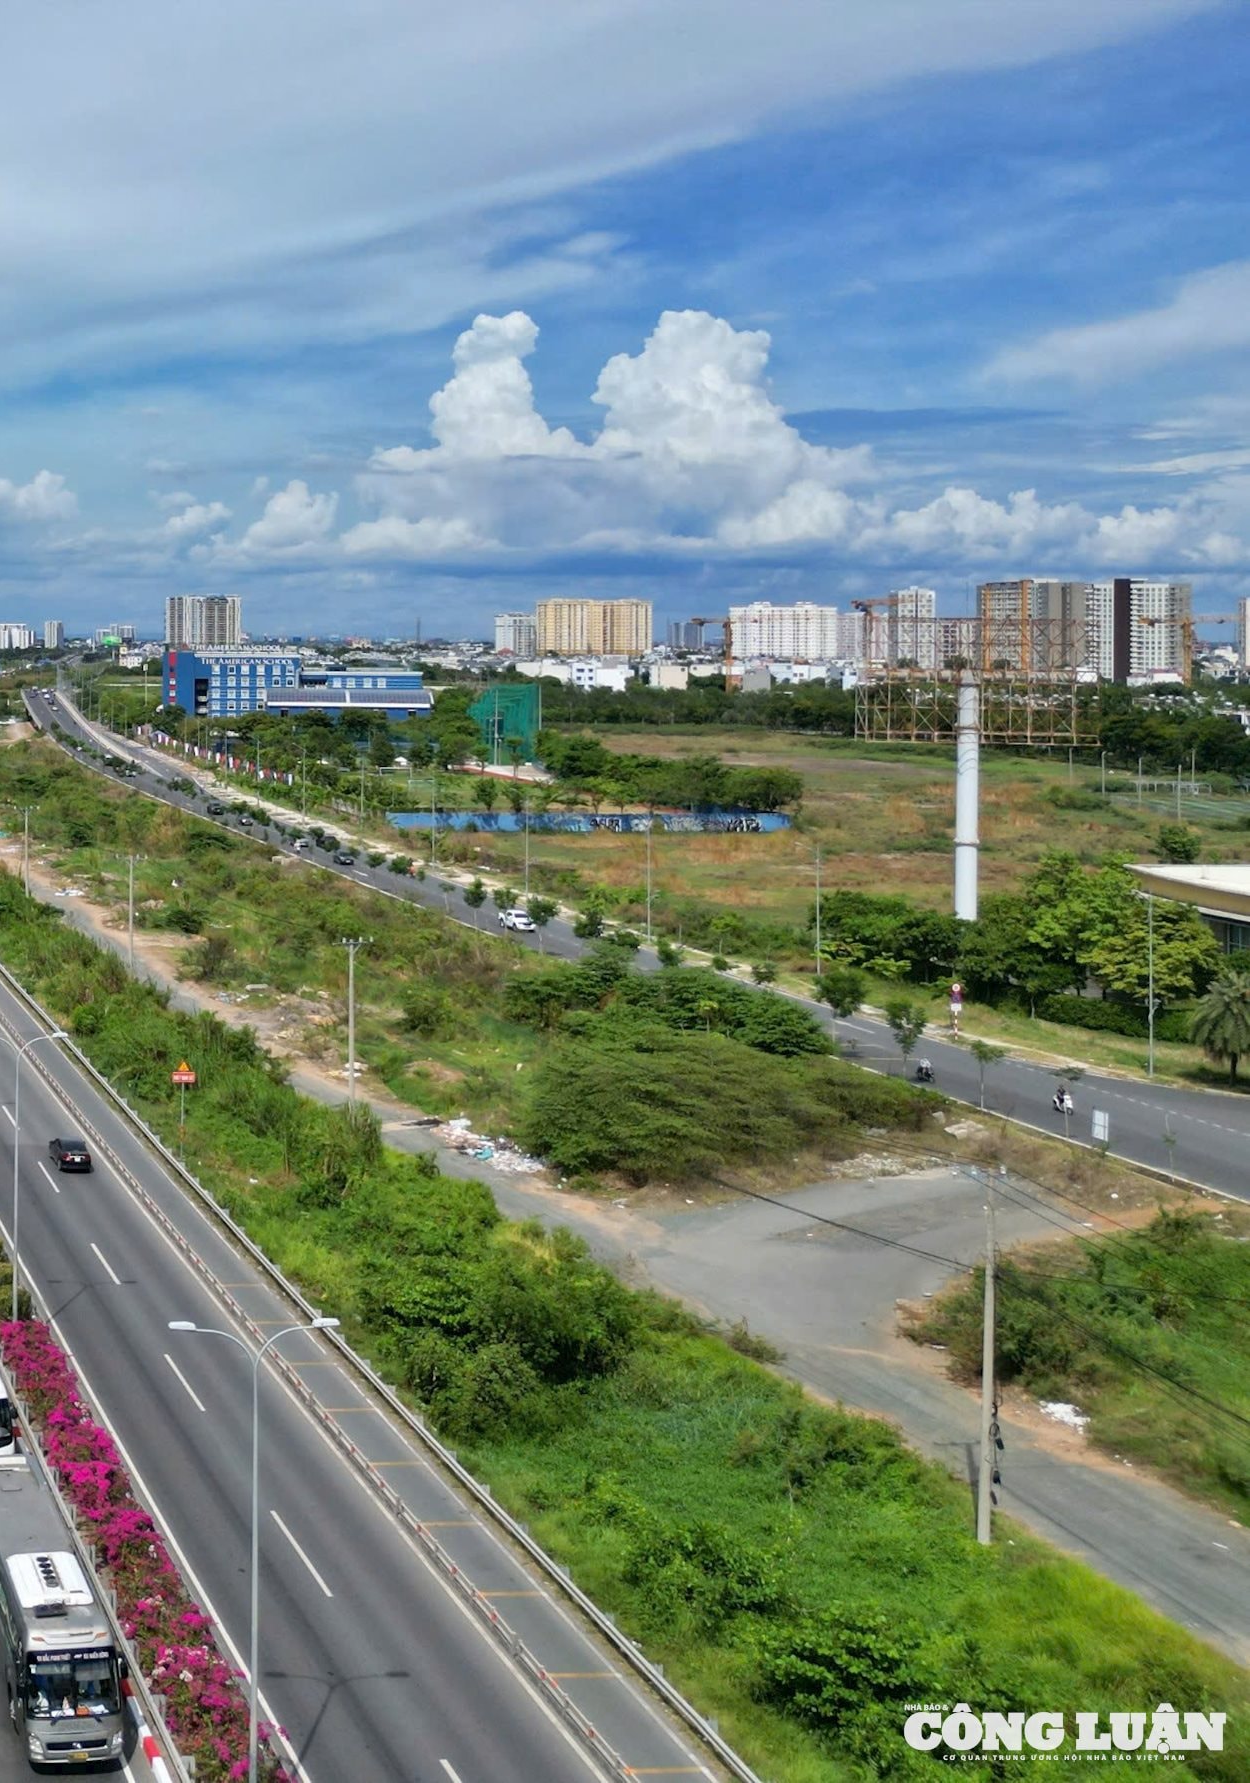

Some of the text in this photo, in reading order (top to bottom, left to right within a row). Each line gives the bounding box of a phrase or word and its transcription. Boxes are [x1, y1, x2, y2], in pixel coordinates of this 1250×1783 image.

[201, 657, 293, 665] THE AMERICAN SCHOOL
